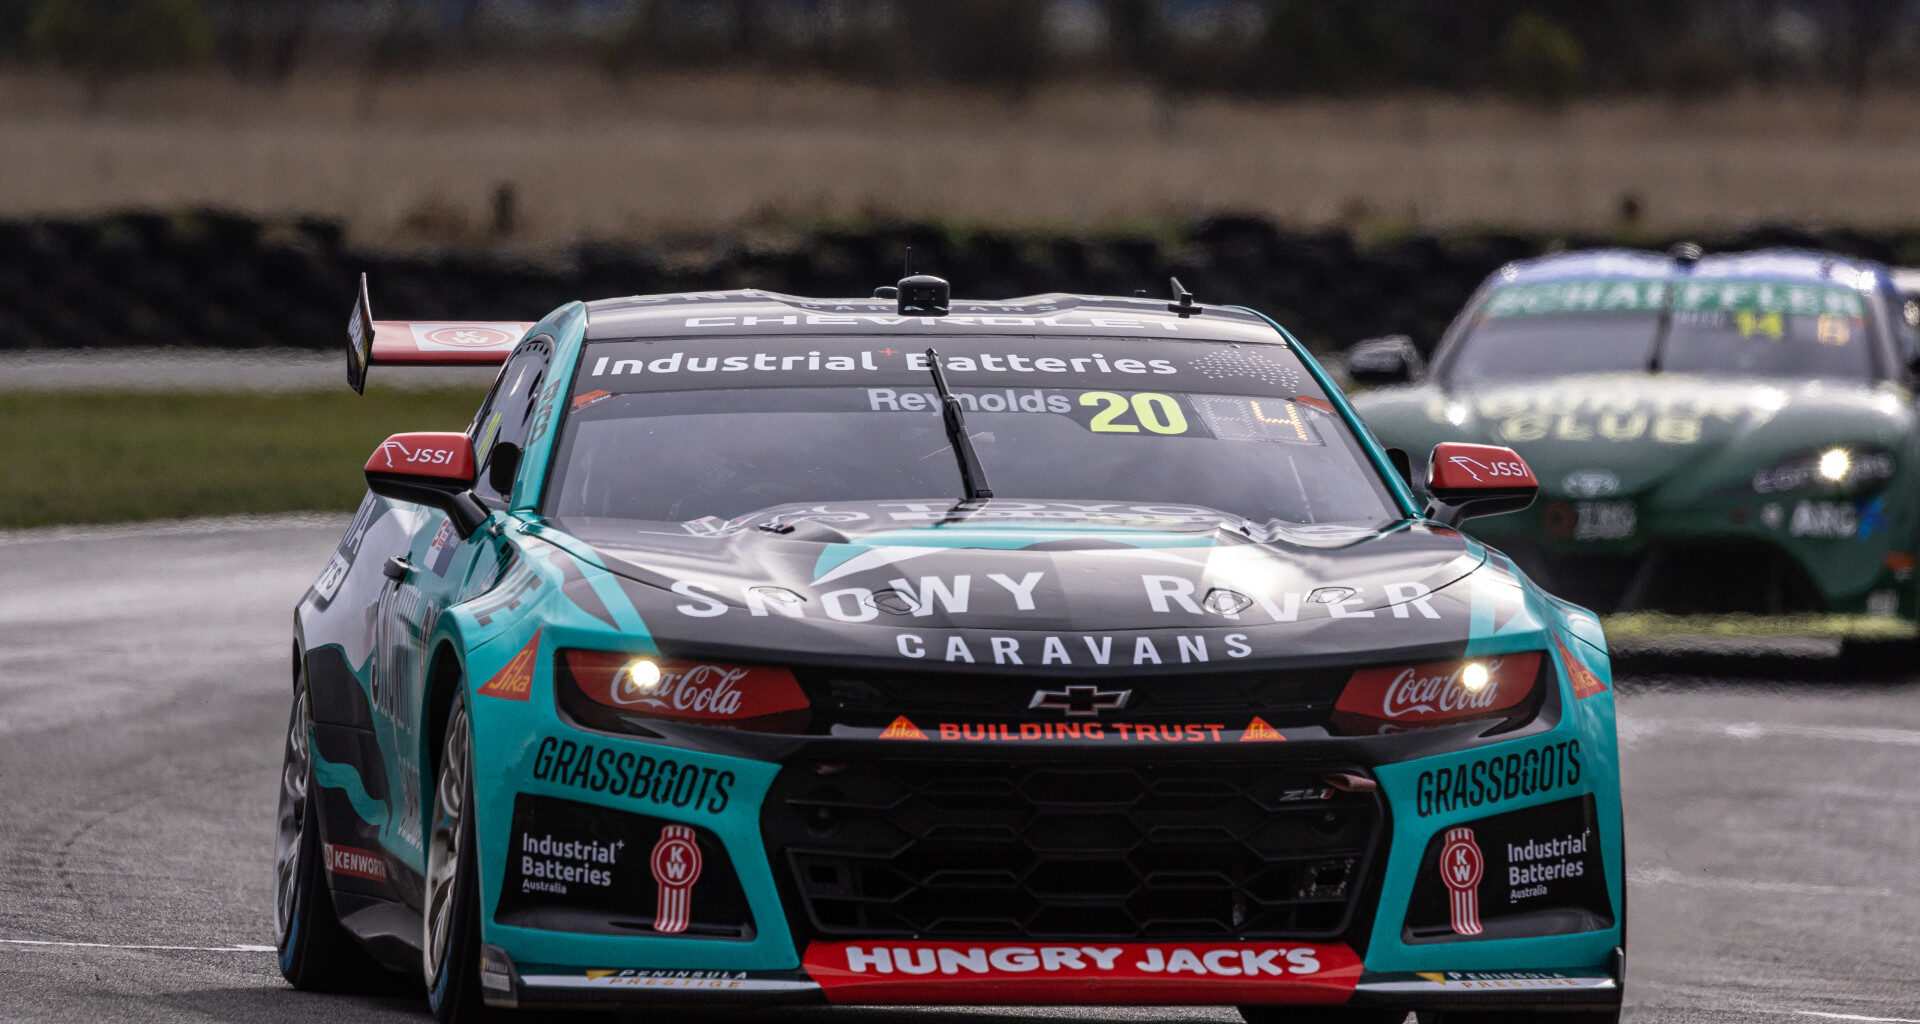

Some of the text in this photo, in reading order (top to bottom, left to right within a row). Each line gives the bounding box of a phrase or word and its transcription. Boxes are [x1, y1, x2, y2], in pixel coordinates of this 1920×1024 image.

[685, 314, 1180, 331] CHEVROLET
[591, 351, 1178, 377] Industrial Batteries
[867, 387, 1072, 417] Reynolds
[1079, 391, 1189, 435] 20
[407, 448, 454, 465] JSSI
[1488, 461, 1529, 478] JSSI
[671, 572, 1442, 622] SNOWY RIVER
[897, 633, 1252, 666] CARAVANS
[489, 650, 535, 694] Sika
[883, 721, 919, 739] Sika
[940, 723, 1224, 742] BUILDING TRUST
[1244, 724, 1279, 741] Sika
[522, 833, 616, 864] Industrial
[1507, 834, 1587, 863] Industrial
[522, 857, 612, 887] Batteries
[1508, 858, 1584, 885] Batteries
[523, 879, 567, 894] Australia
[1510, 885, 1547, 899] Australia
[846, 946, 1320, 976] HUNGRY JACK'S
